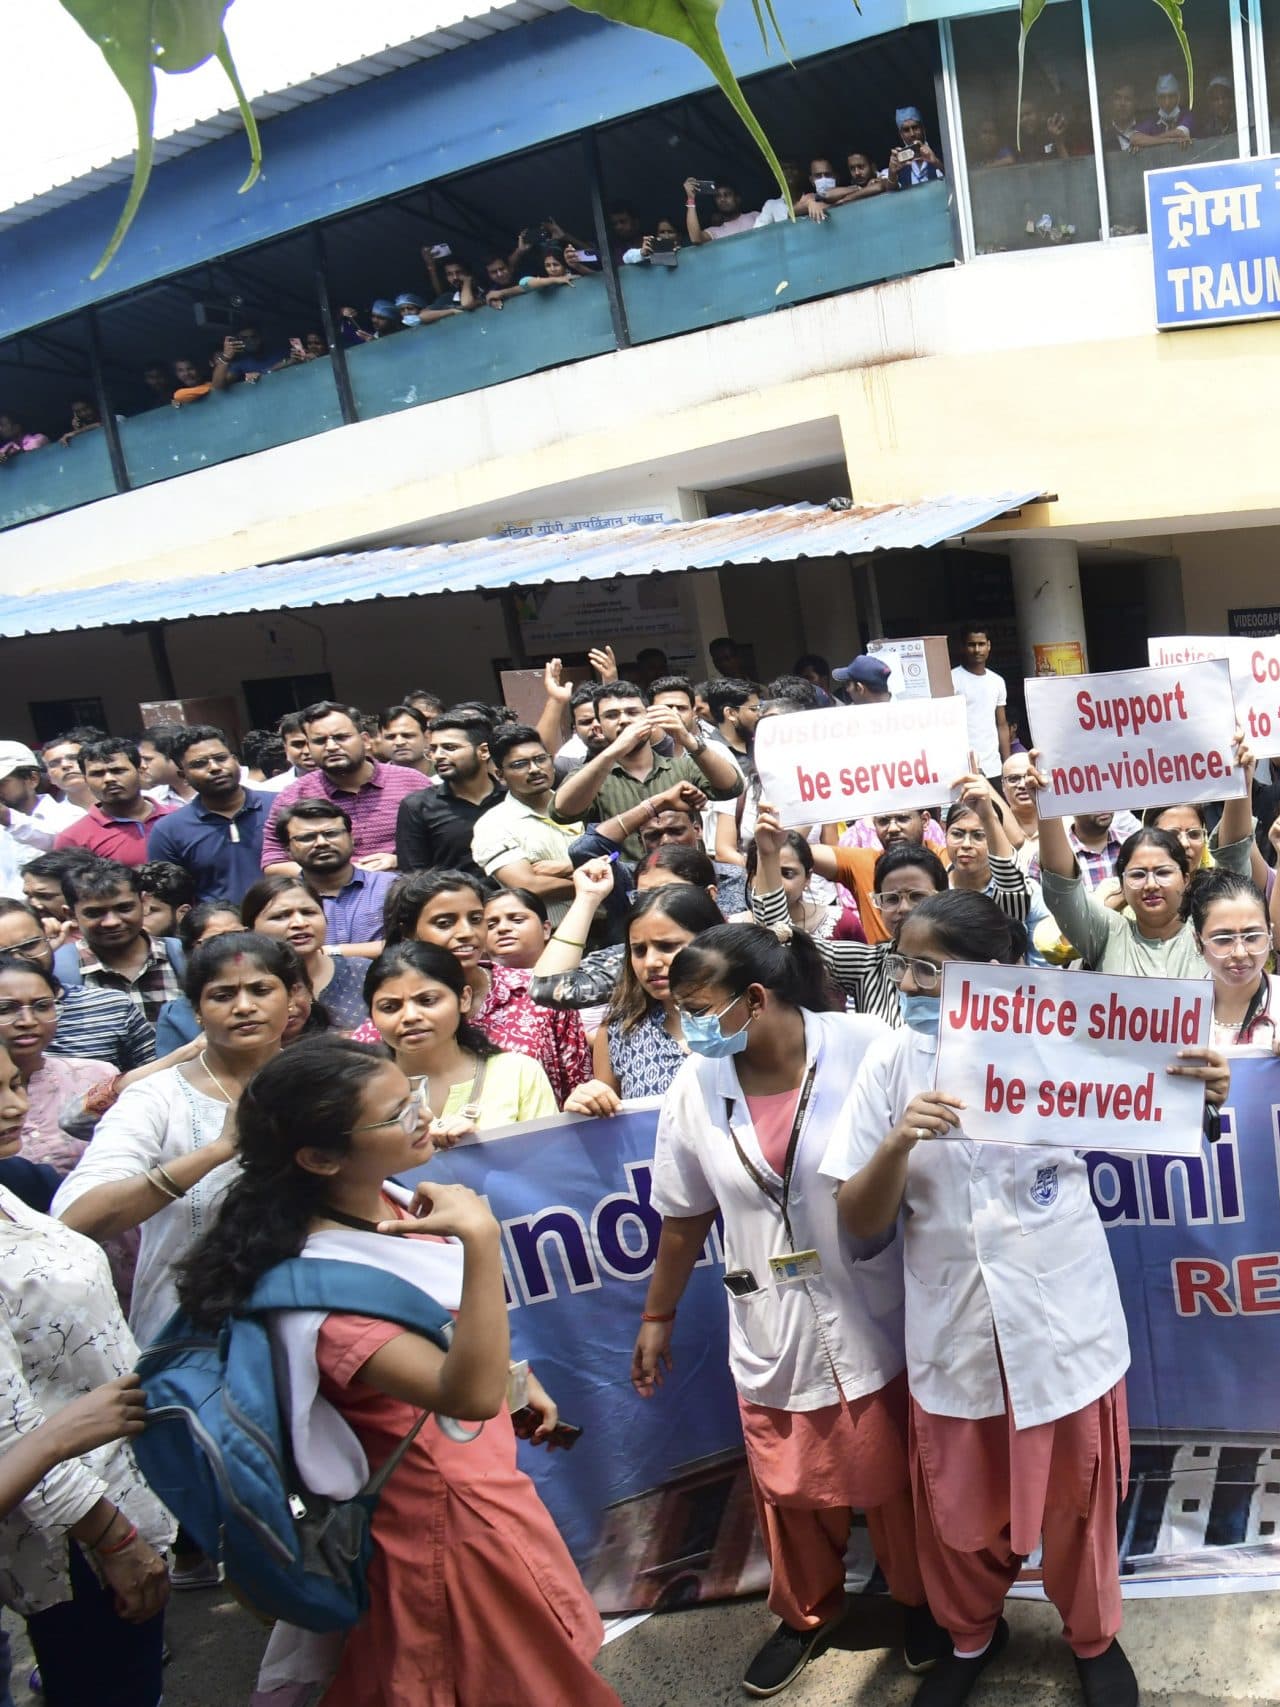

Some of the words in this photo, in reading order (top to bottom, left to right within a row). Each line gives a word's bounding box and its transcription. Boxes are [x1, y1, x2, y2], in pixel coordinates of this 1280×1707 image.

[1162, 181, 1263, 249] ट्रोमा
[1077, 681, 1188, 737] Support
[1248, 708, 1272, 738] to
[797, 765, 832, 802] be
[839, 749, 940, 797] served.
[1052, 748, 1232, 796] non-violence.
[949, 981, 1077, 1036] Justice
[1088, 992, 1202, 1045] should
[985, 1064, 1025, 1115] be
[1037, 1072, 1162, 1122] served.
